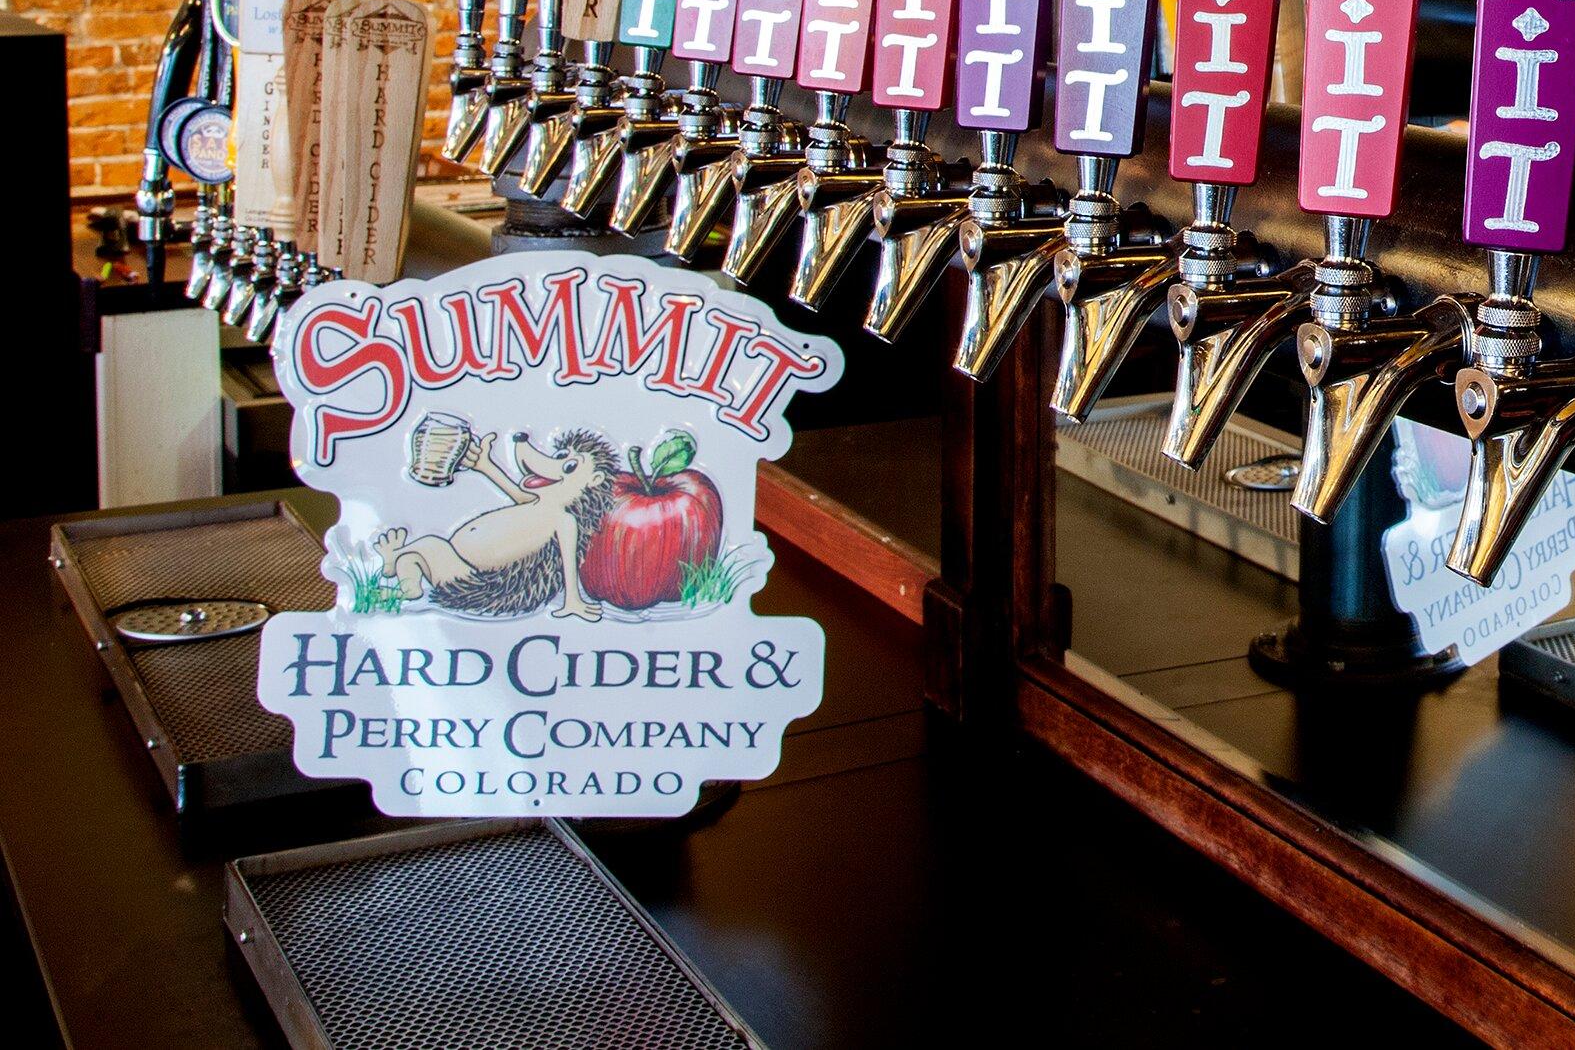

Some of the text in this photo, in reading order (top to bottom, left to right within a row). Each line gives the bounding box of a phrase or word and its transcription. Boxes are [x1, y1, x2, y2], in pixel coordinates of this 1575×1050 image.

[261, 81, 274, 170] GINGER
[363, 63, 390, 265] HARD CIDER
[297, 267, 827, 467] SUMMIT
[284, 634, 802, 697] HARD CIDER &
[317, 709, 768, 759] PERRY COMPANY
[401, 768, 683, 796] COLORADO
